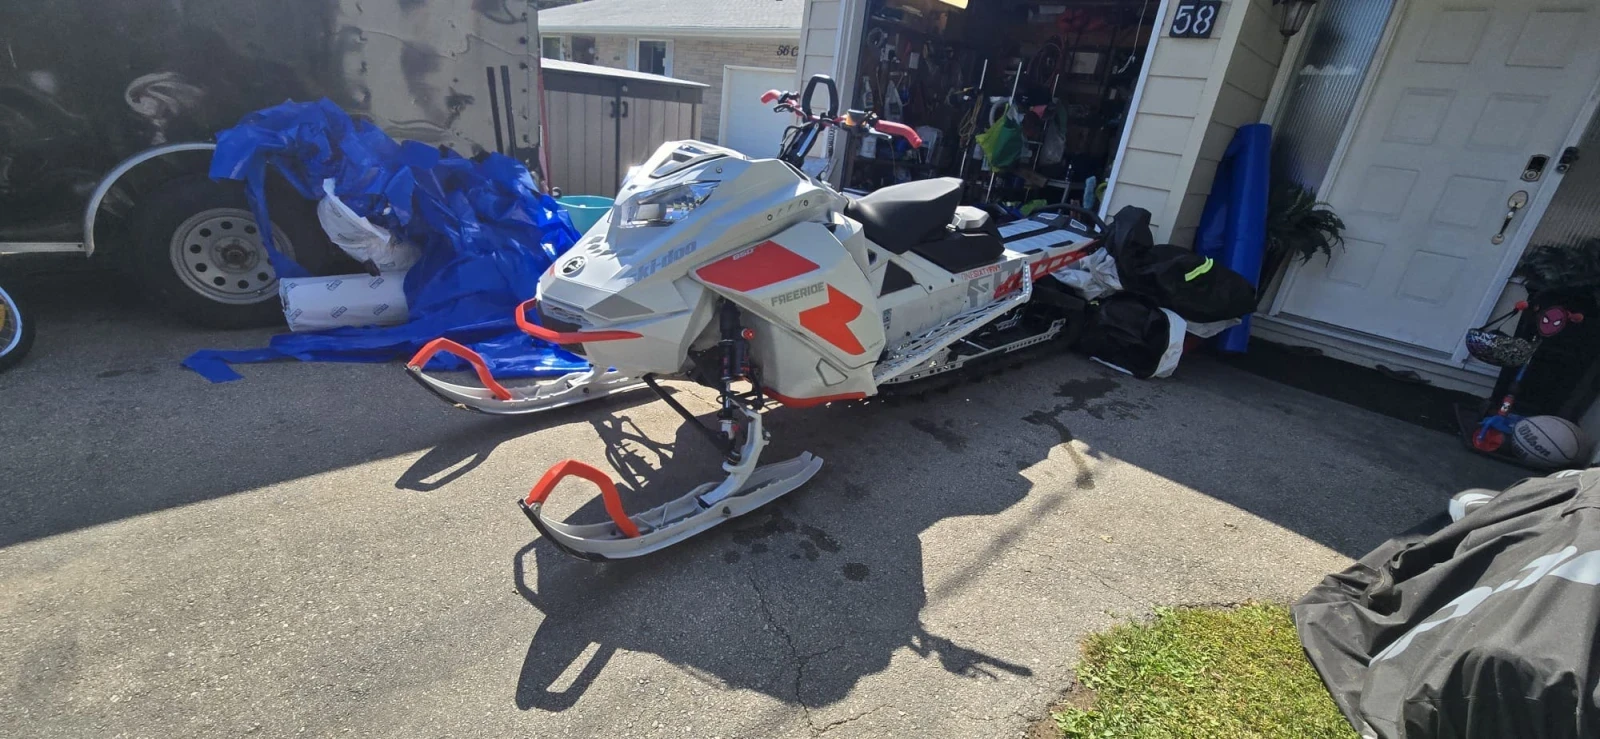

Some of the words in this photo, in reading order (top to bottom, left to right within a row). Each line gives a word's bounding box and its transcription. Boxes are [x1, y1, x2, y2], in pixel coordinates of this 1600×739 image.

[1173, 5, 1215, 34] 58
[733, 248, 755, 261] 850
[770, 281, 825, 307] FREERIDE
[1517, 424, 1551, 457] Wilson
